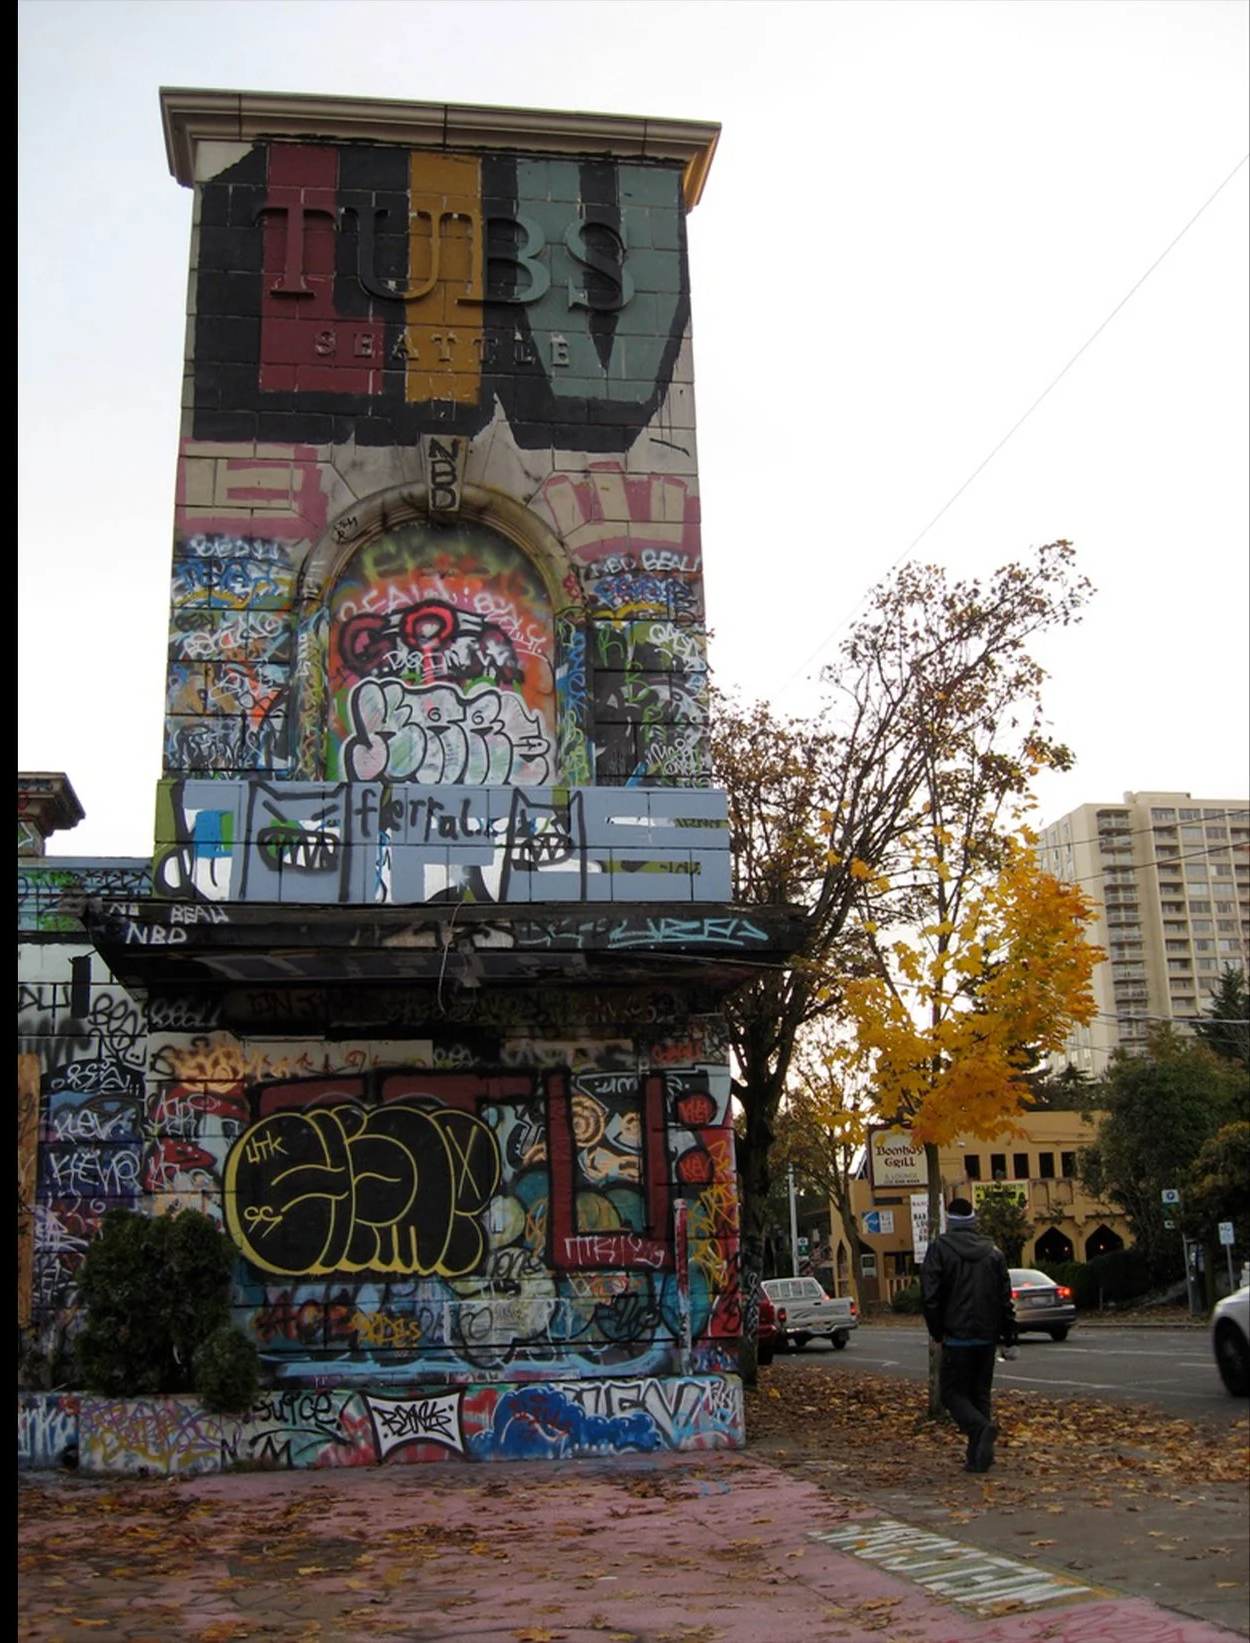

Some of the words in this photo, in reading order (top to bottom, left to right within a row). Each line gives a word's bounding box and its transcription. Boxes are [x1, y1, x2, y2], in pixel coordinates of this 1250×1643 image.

[253, 202, 636, 314] TUBS
[314, 328, 572, 368] SEATTLE
[126, 922, 188, 945] NBD
